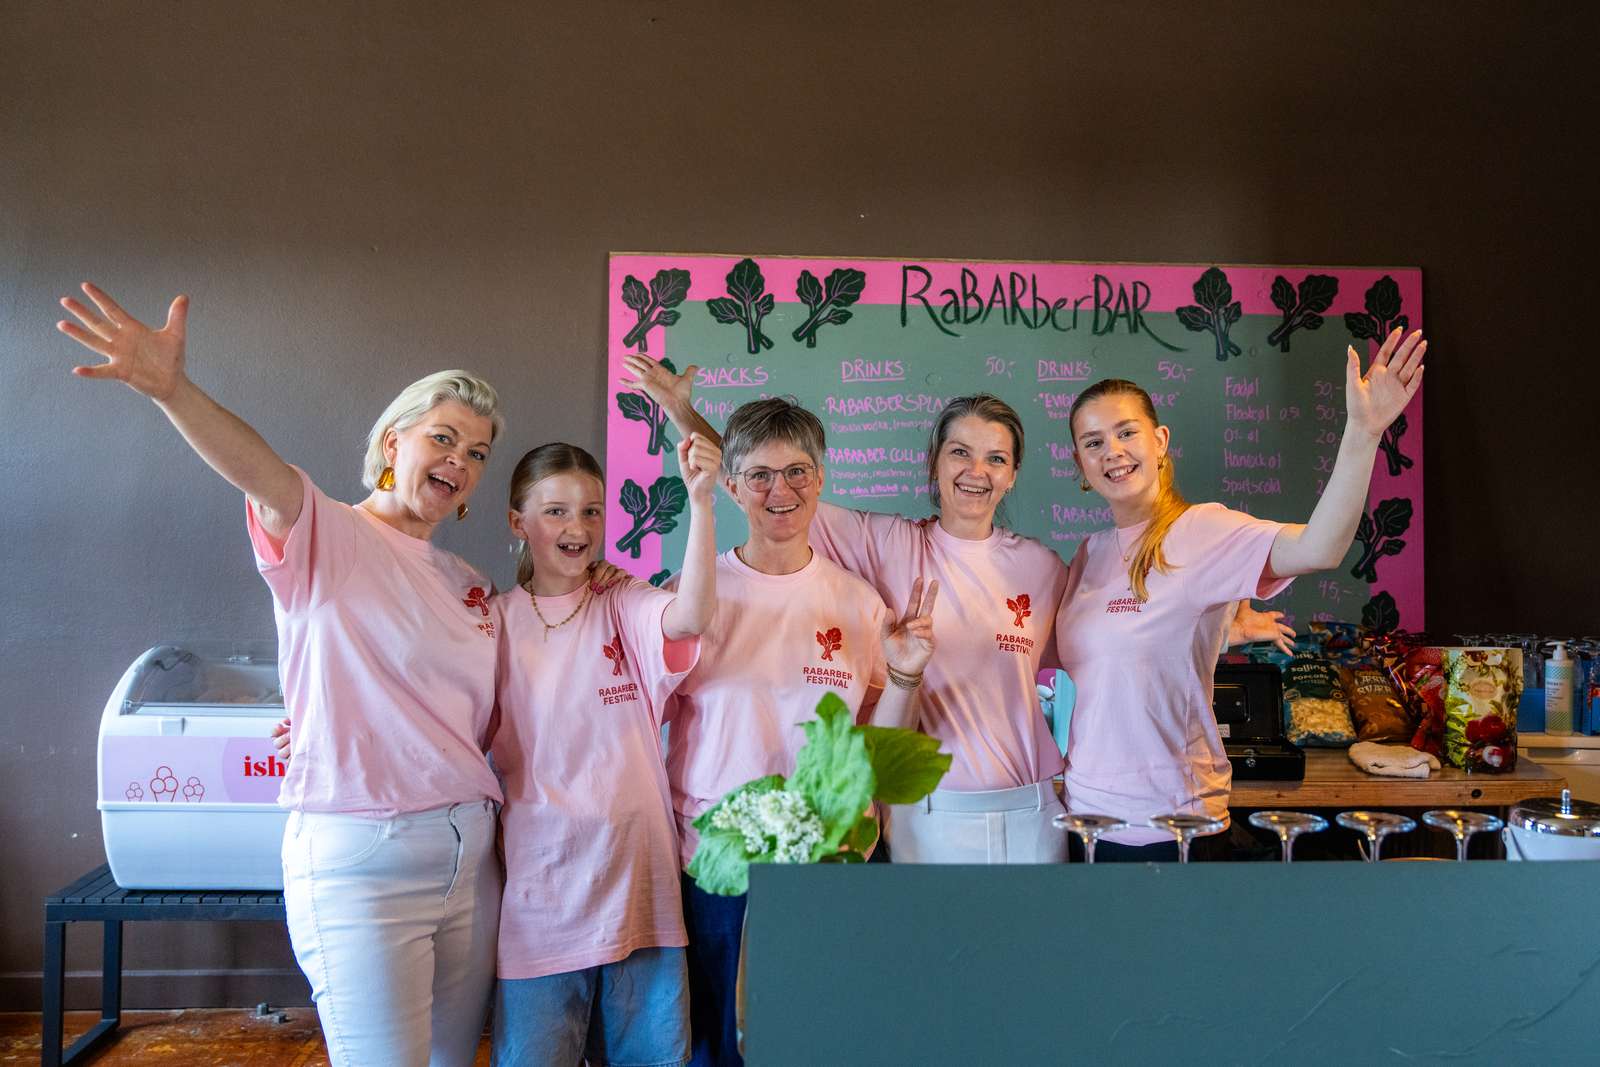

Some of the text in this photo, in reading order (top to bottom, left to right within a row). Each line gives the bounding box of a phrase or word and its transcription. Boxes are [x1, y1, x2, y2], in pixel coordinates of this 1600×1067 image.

[1106, 605, 1142, 614] FESTIVAL
[803, 666, 853, 681] RABARBER
[806, 675, 849, 689] FESTIVAL
[244, 755, 288, 777] ish
